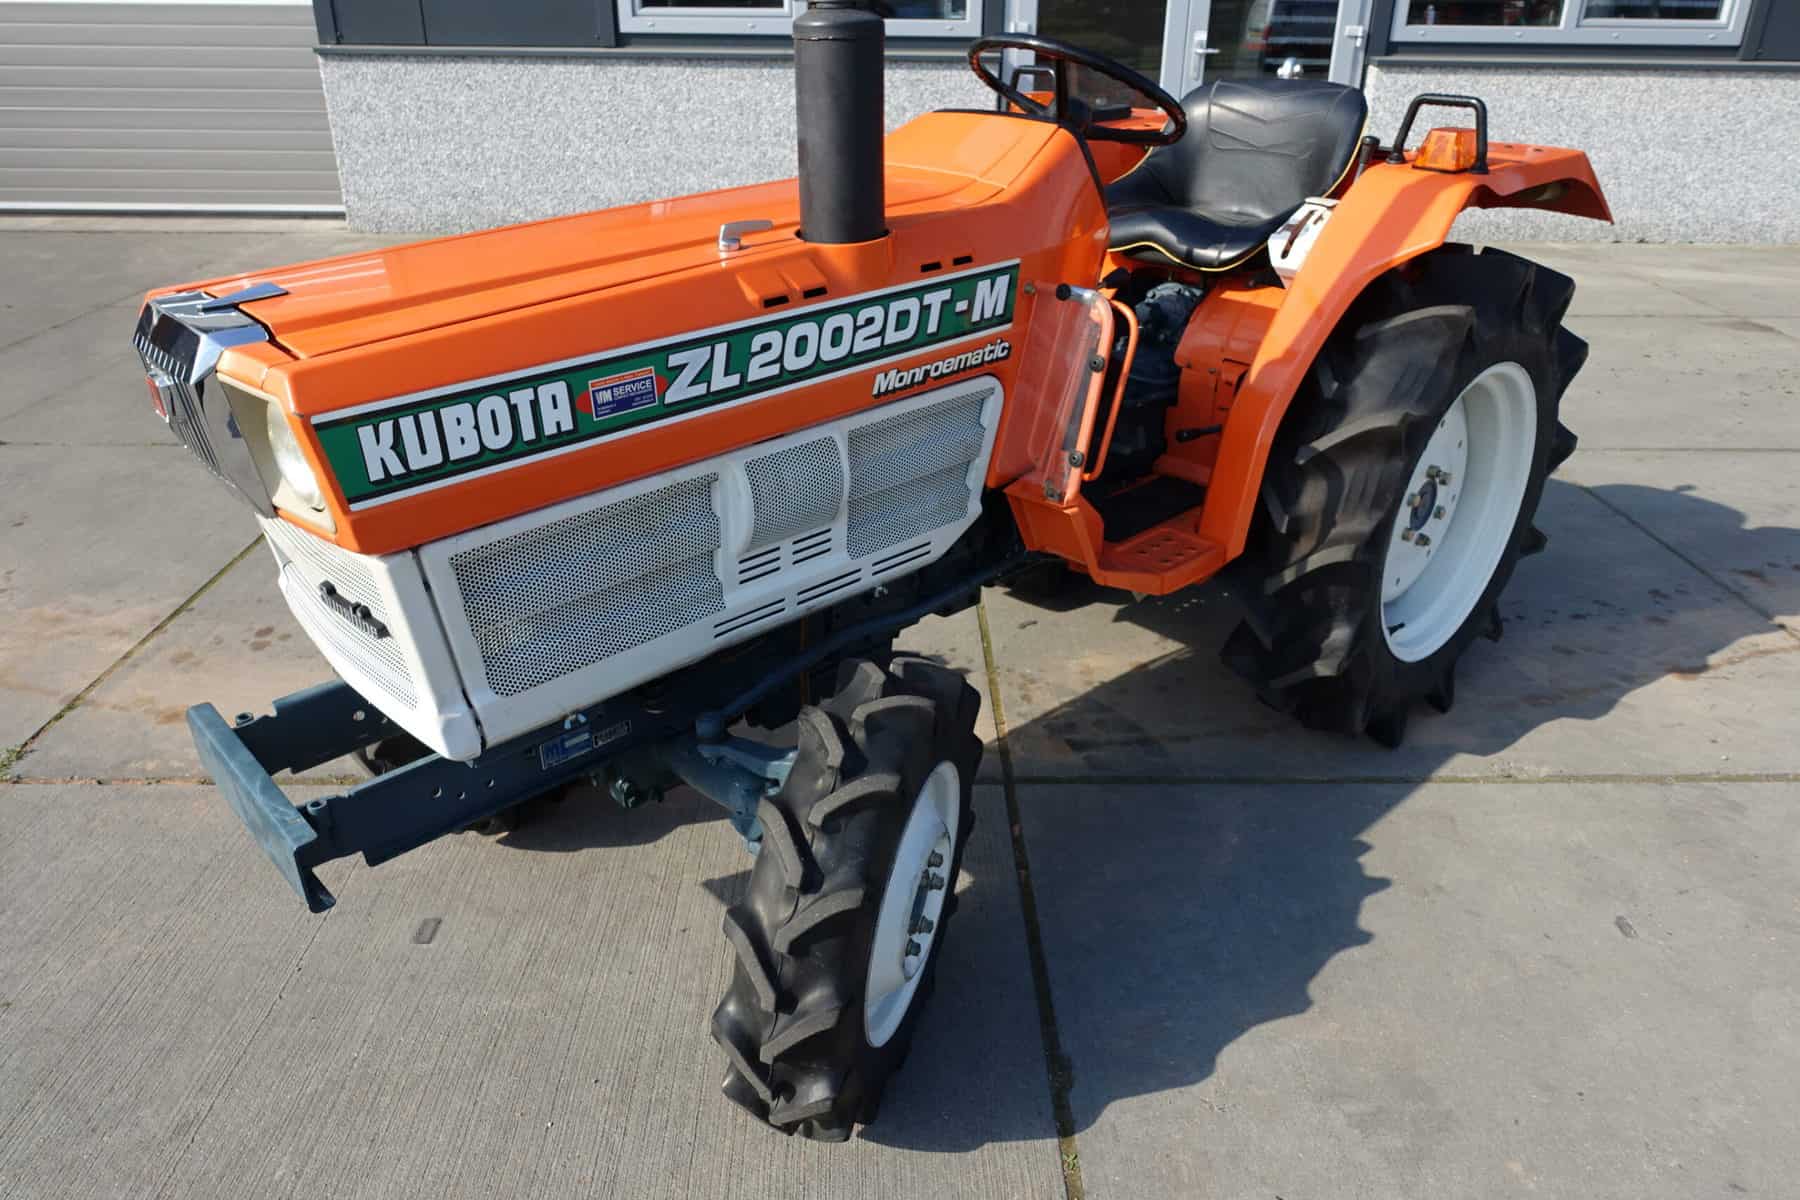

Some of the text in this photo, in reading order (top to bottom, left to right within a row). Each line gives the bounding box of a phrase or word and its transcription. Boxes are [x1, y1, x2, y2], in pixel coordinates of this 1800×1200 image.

[613, 378, 653, 396] SERVICE
[871, 339, 1012, 398] Monroematic
[356, 380, 575, 483] KUBOTA
